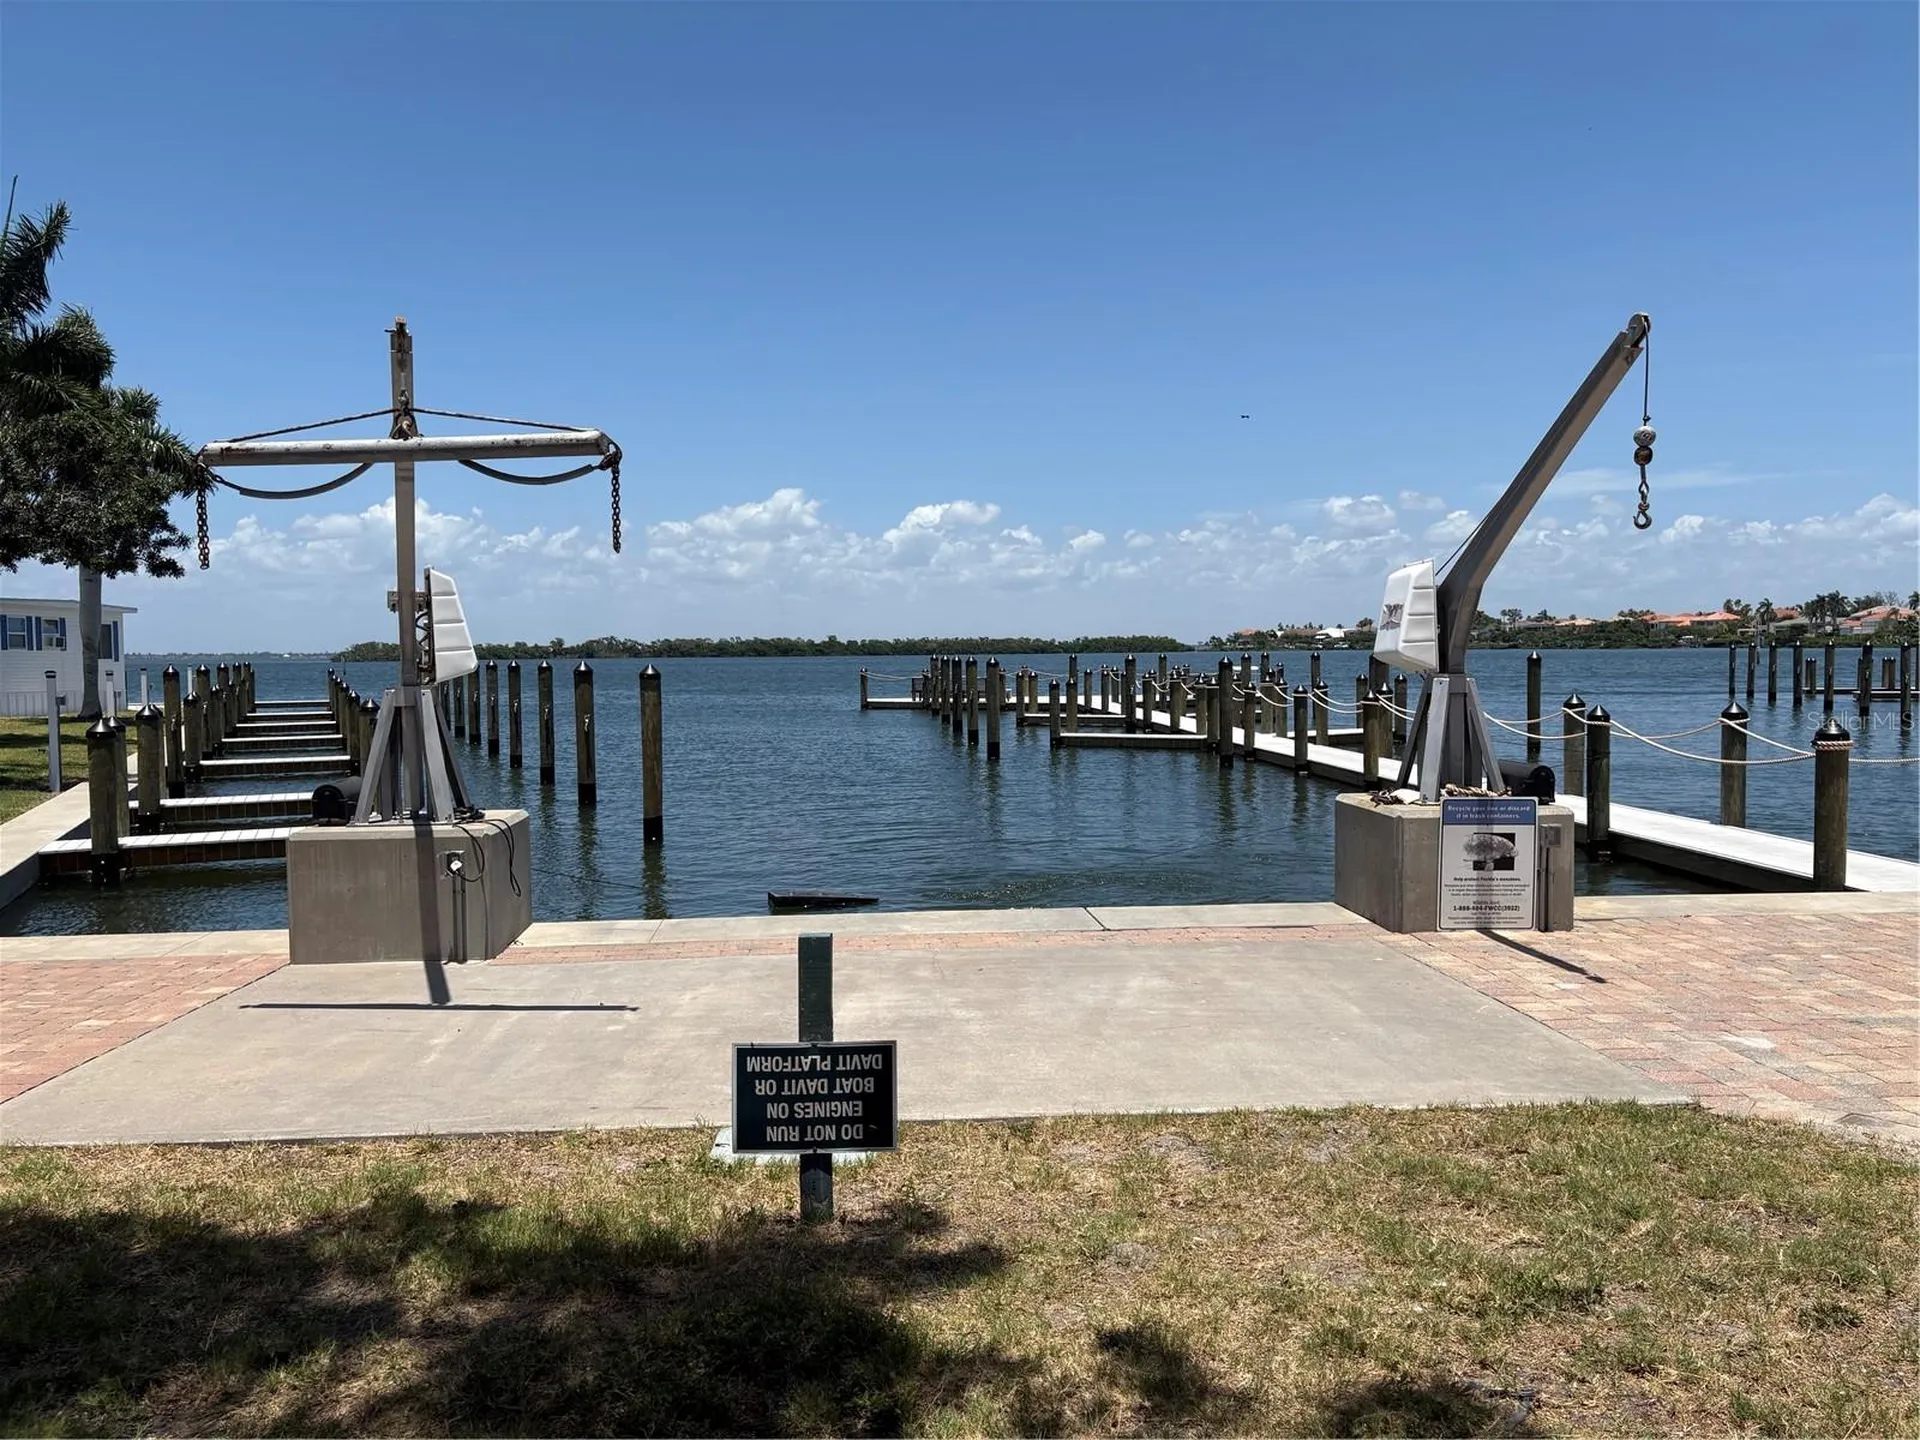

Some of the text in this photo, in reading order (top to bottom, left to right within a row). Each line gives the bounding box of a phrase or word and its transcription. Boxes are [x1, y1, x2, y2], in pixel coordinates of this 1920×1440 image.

[746, 1054, 883, 1072] DAVIT PLATFORM
[755, 1077, 875, 1096] BOAT DAVIT OR
[766, 1100, 863, 1119] ENGINES ON
[766, 1123, 864, 1142] DO NOT RUN
